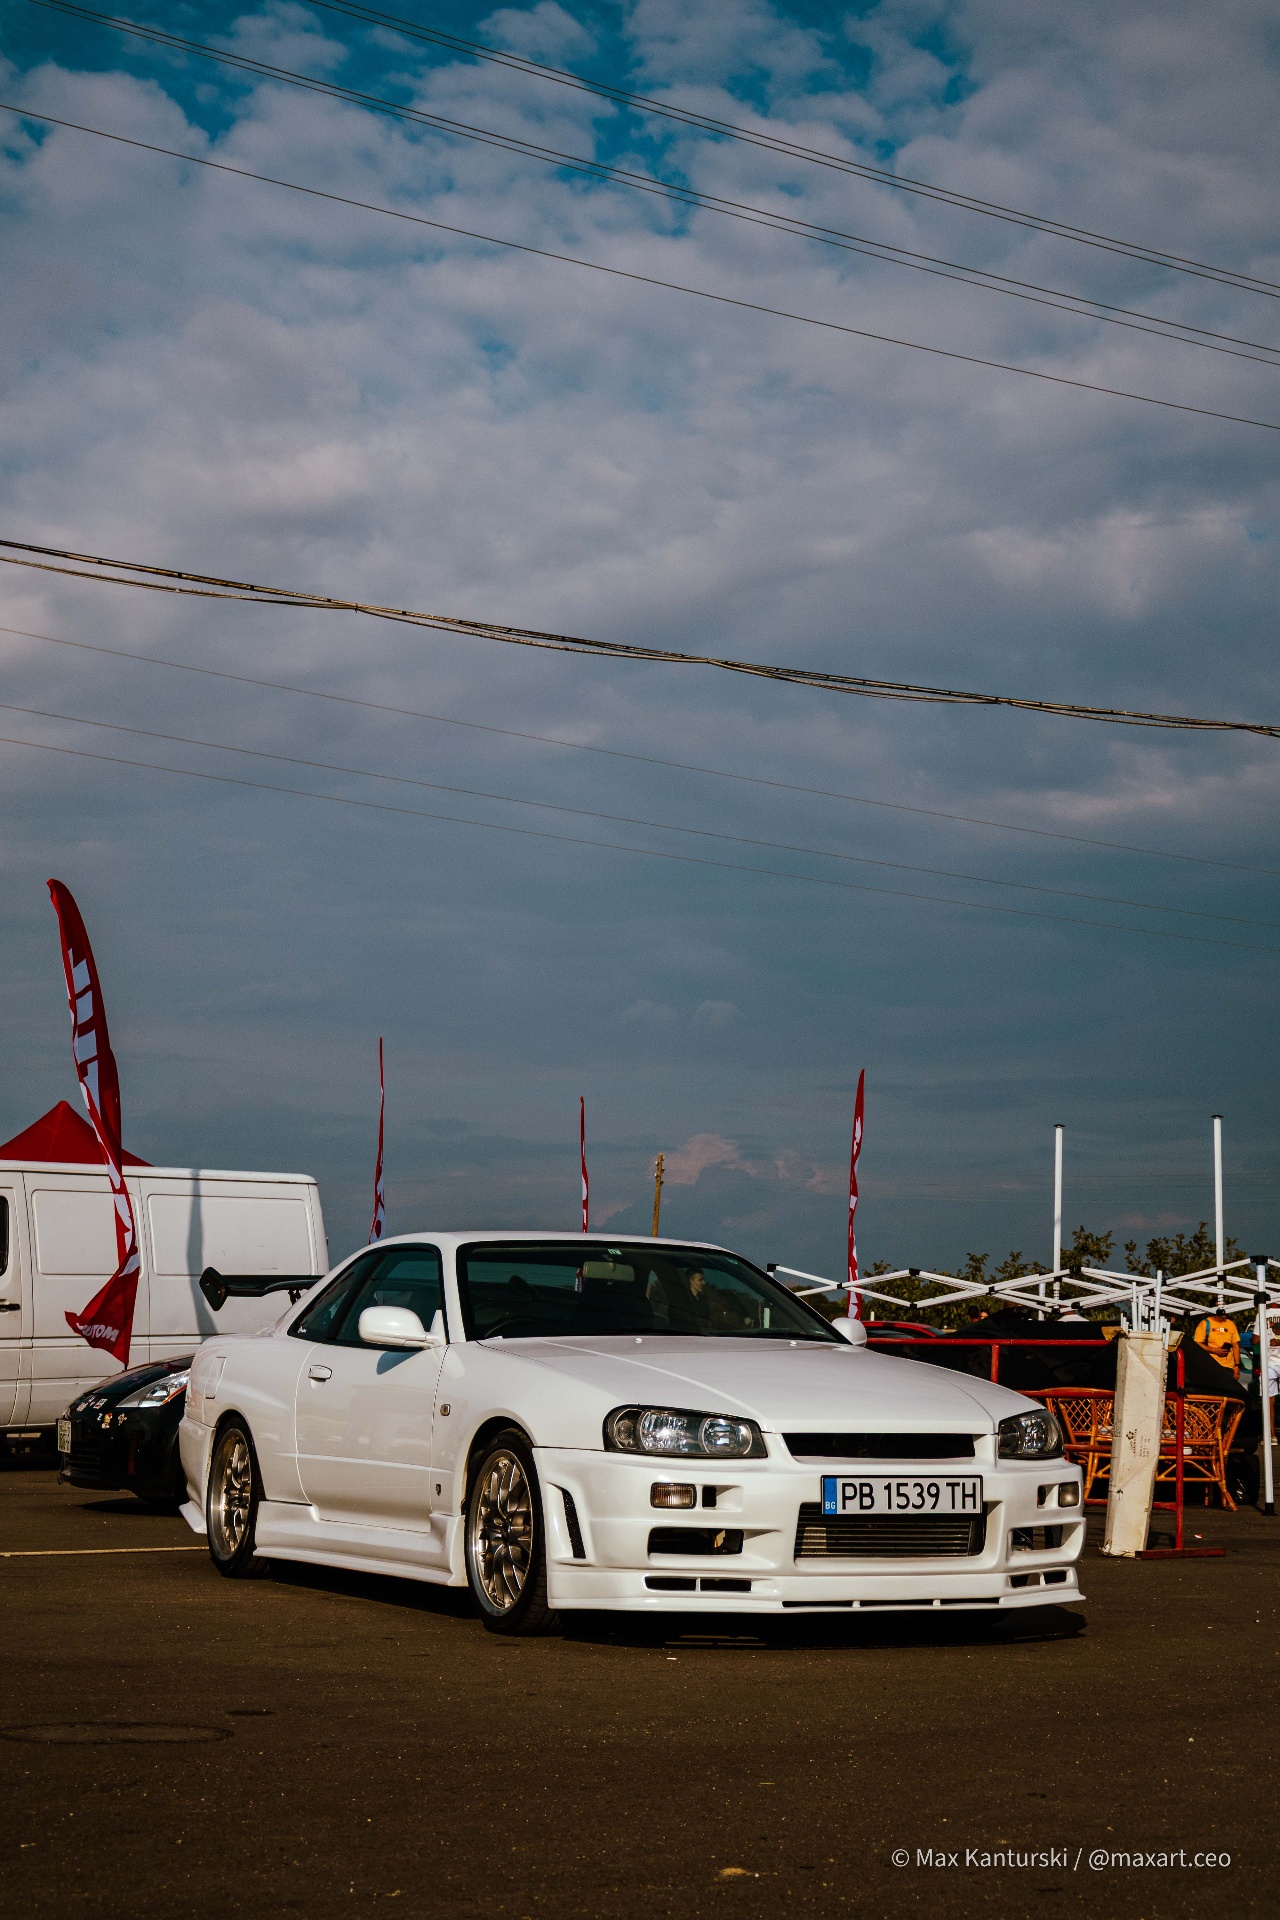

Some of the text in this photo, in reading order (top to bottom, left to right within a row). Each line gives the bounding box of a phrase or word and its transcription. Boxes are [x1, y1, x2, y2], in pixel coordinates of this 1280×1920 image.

[841, 1482, 977, 1510] PB 1539 TH
[825, 1501, 836, 1510] BG
